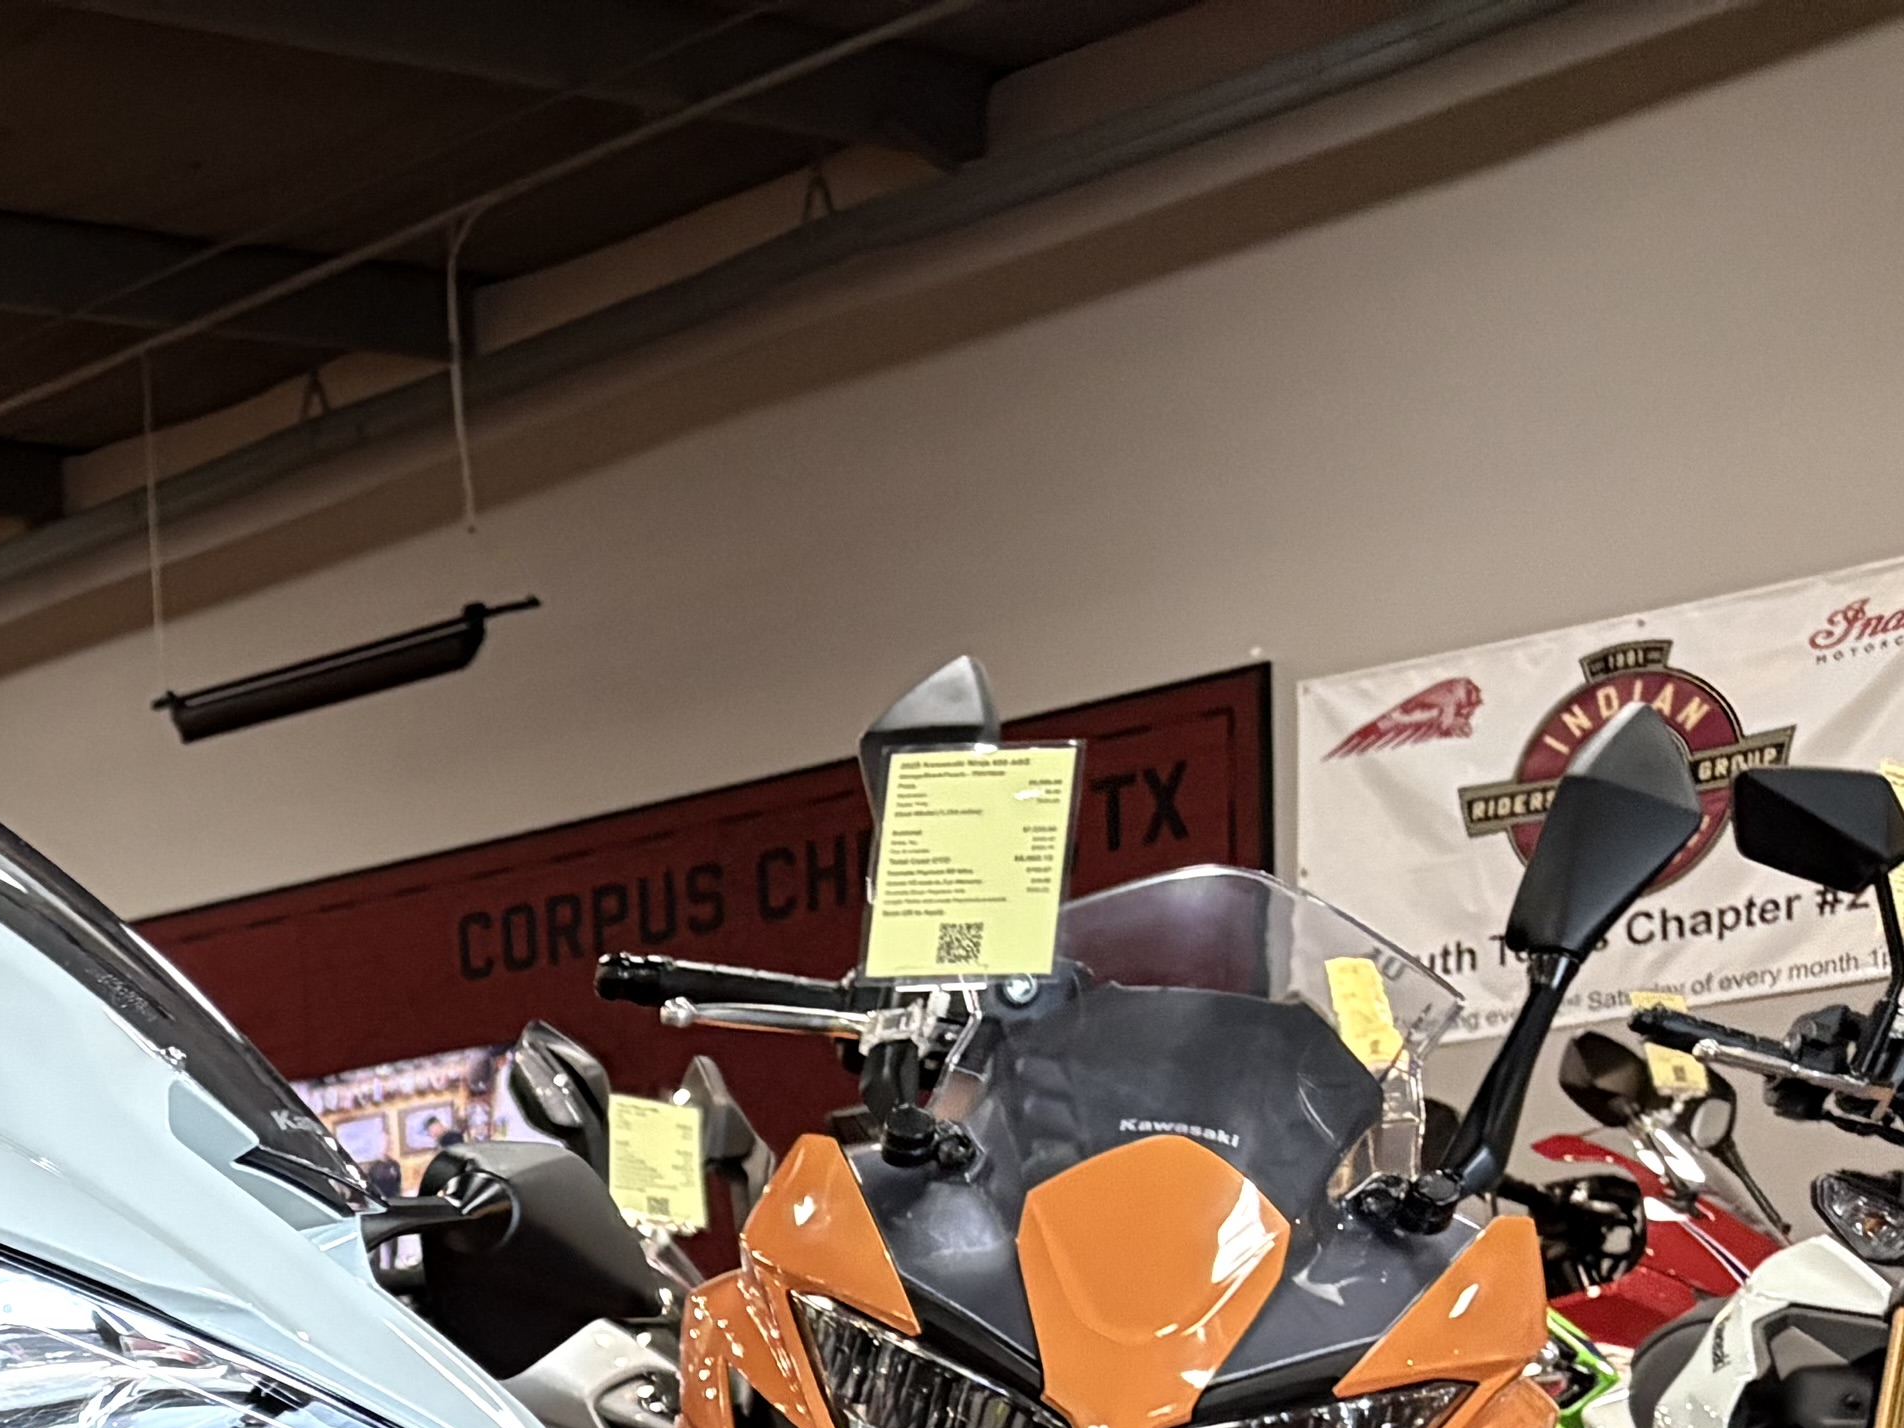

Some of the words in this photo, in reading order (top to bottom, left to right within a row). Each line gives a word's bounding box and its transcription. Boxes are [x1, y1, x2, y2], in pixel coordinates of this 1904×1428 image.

[1544, 680, 1710, 755] INDIAN
[458, 864, 724, 980] CORPUS
[1094, 758, 1191, 853] TX
[1625, 890, 1802, 947] Chapter
[1691, 972, 1715, 995] of
[1719, 964, 1786, 995] every
[1788, 954, 1860, 981] month
[1119, 1117, 1240, 1148] Kawasaki
